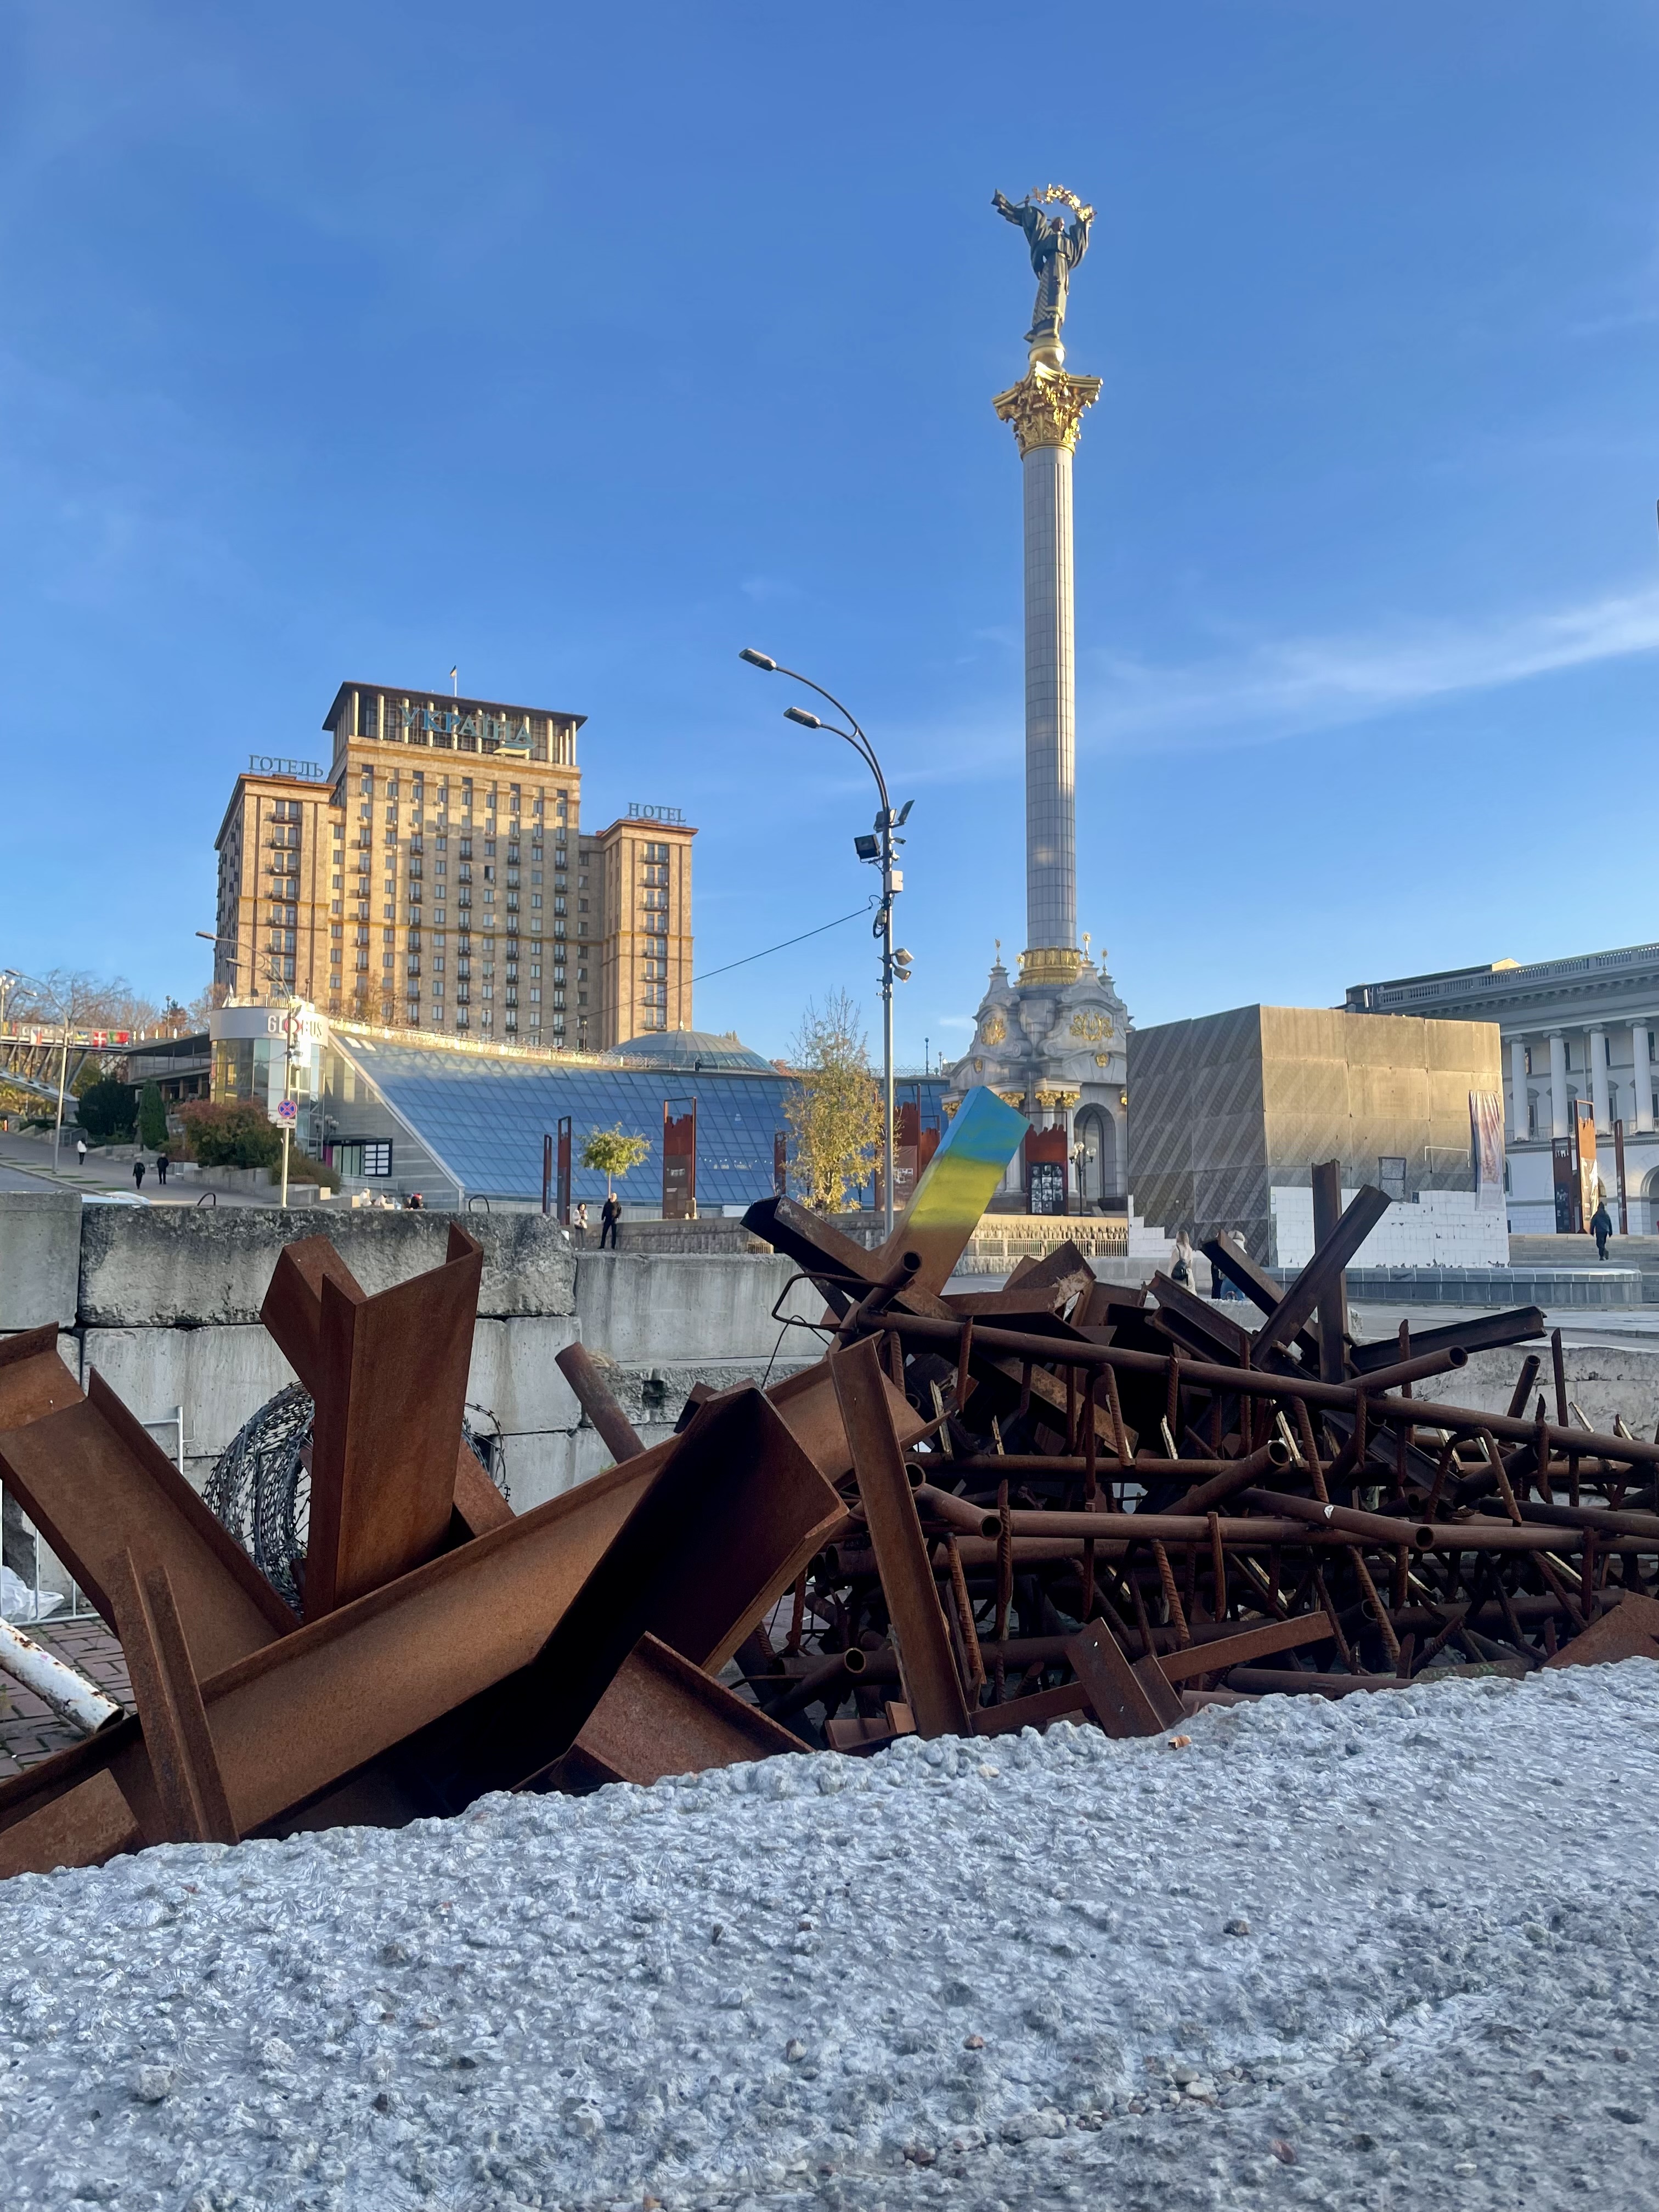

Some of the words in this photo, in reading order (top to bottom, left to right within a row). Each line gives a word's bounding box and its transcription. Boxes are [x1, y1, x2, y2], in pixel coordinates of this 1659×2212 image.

[399, 704, 535, 745] УКРАЇНА
[249, 754, 324, 777] ГОТЕЛЬ
[628, 802, 686, 822] HOTEL
[267, 1015, 323, 1039] GLOBUS
